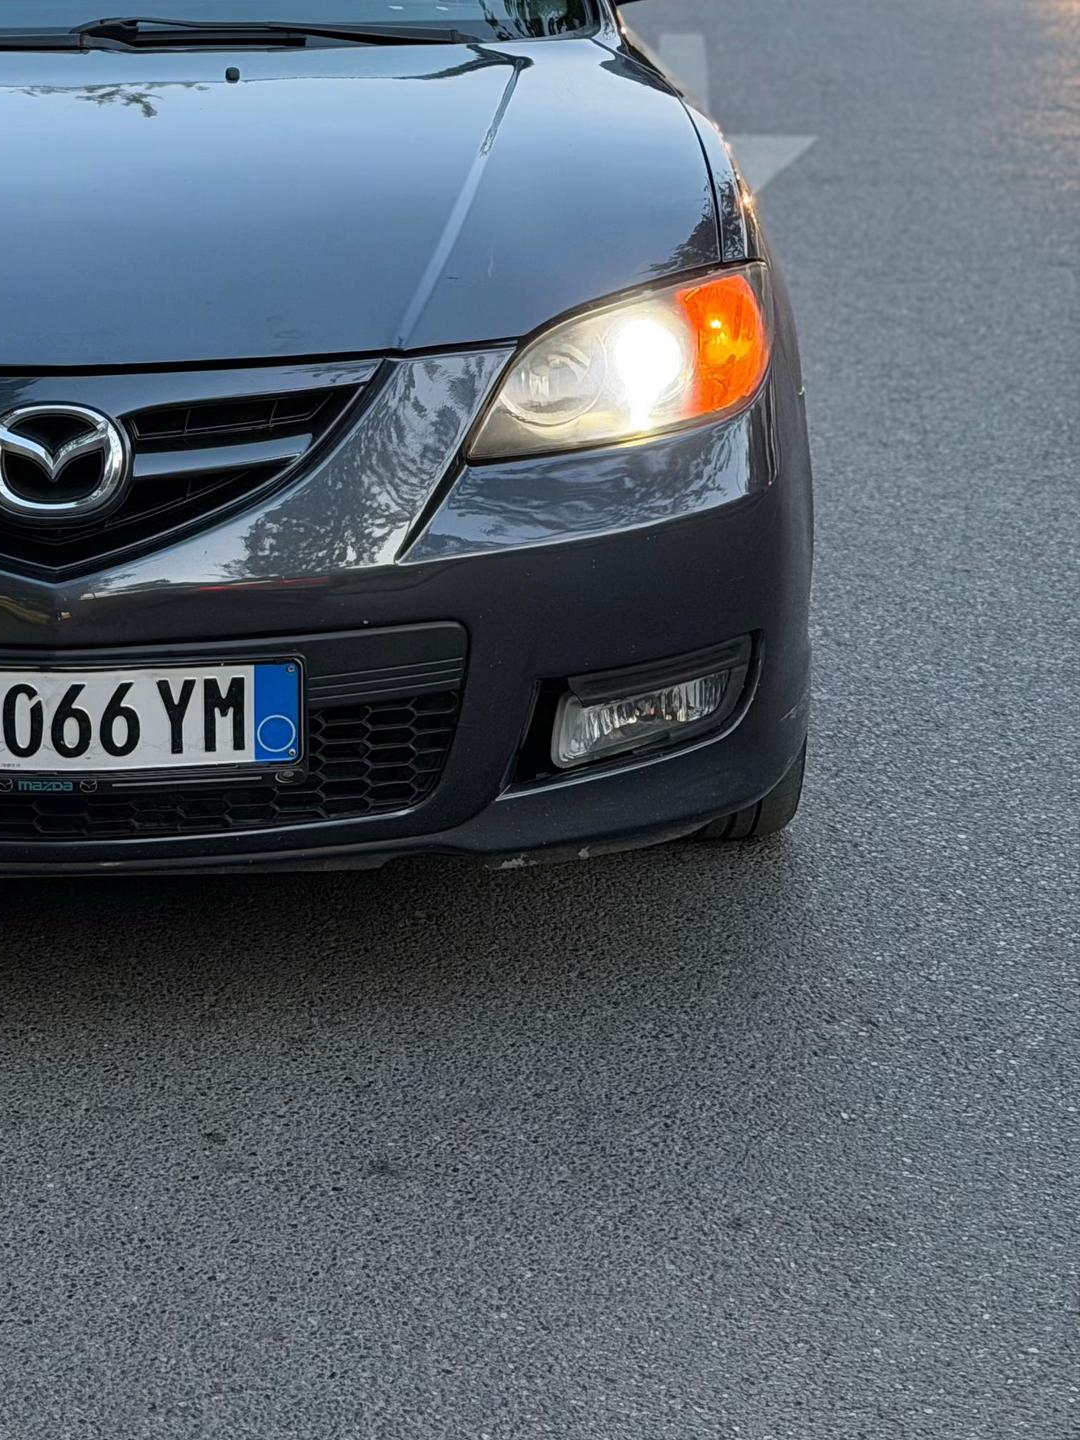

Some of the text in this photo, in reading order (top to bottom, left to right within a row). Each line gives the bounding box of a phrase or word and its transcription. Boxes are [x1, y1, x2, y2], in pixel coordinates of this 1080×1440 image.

[2, 681, 142, 759] 066
[155, 676, 248, 755] YM
[17, 779, 74, 792] mazda
